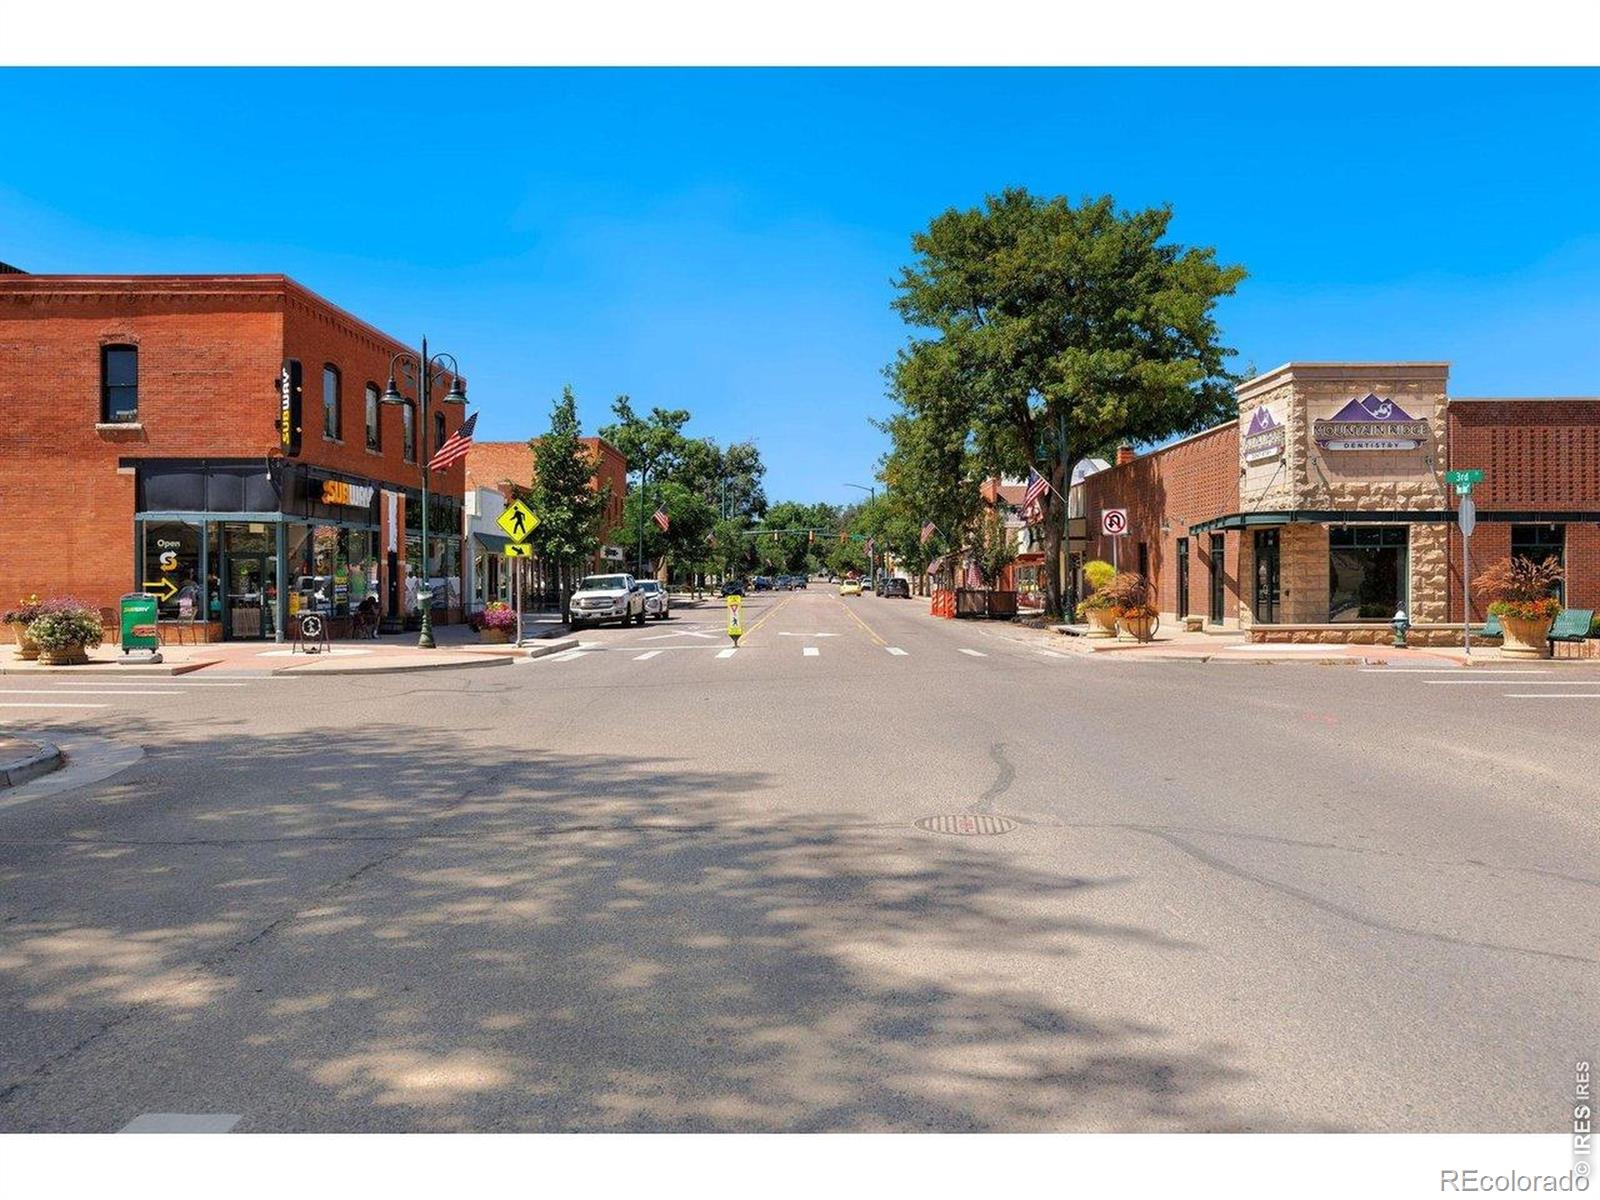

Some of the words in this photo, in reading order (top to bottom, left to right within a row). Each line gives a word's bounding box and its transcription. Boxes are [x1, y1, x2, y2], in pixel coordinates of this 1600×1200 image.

[282, 366, 290, 445] SUBWAY
[1455, 471, 1469, 482] 3rd
[321, 479, 375, 508] SUBWAY
[157, 539, 181, 549] Open
